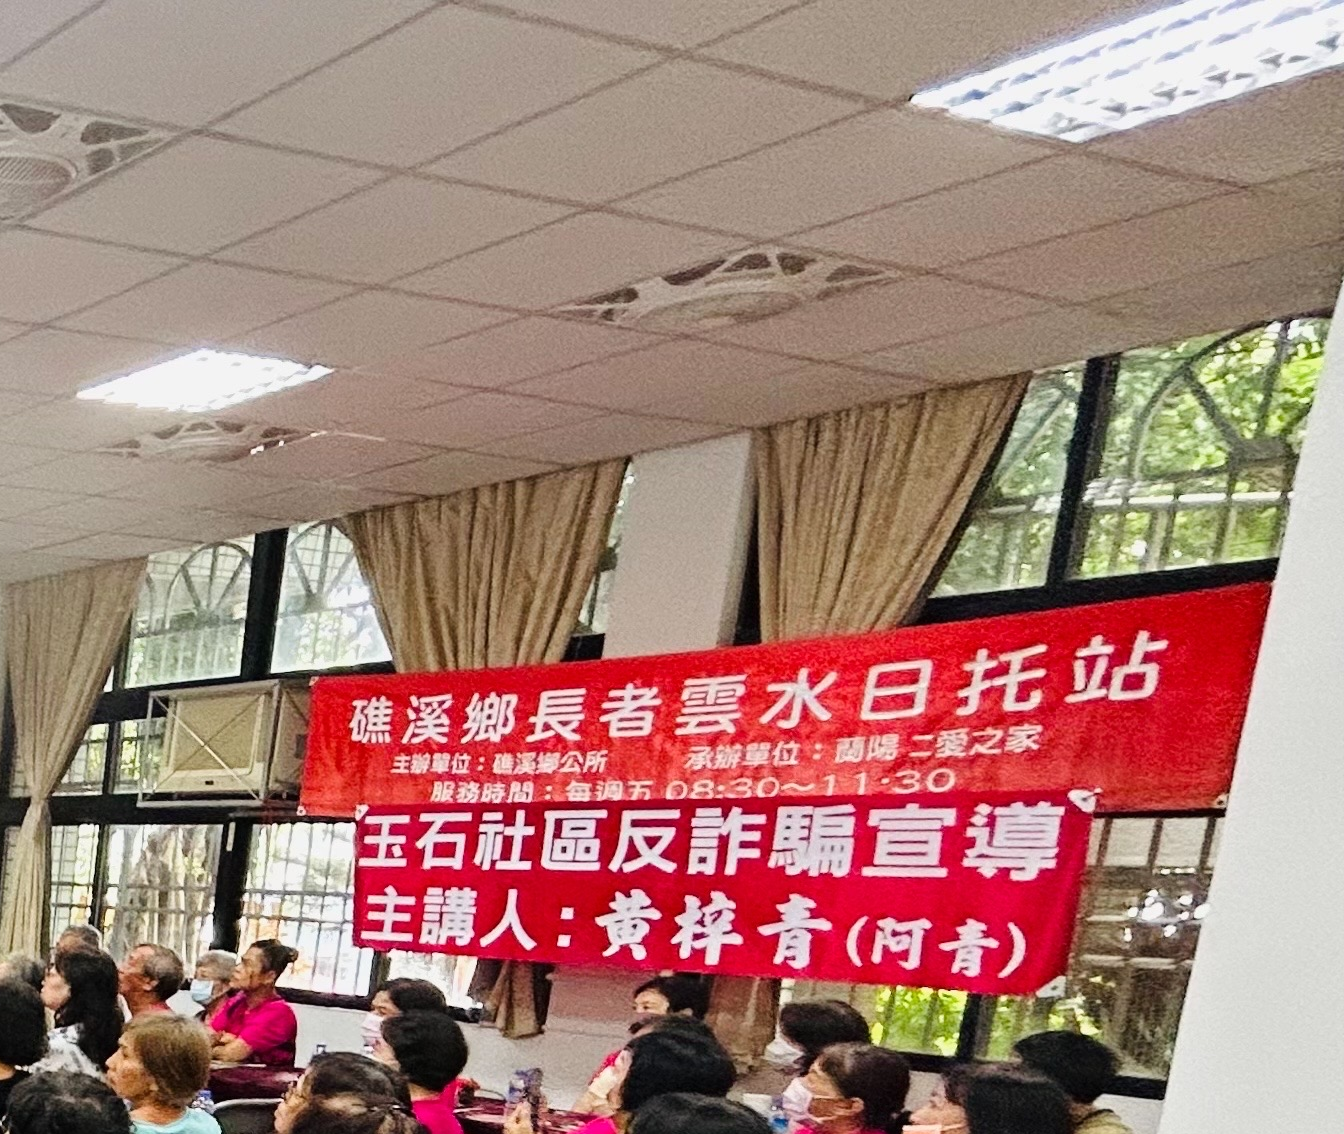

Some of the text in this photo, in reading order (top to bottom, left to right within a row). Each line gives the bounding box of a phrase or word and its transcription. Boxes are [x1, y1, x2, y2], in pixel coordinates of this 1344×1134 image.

[348, 629, 1170, 747] 礁溪鄉長者雲水日托站
[358, 802, 1066, 883] 玉石社區反詐騙宣導
